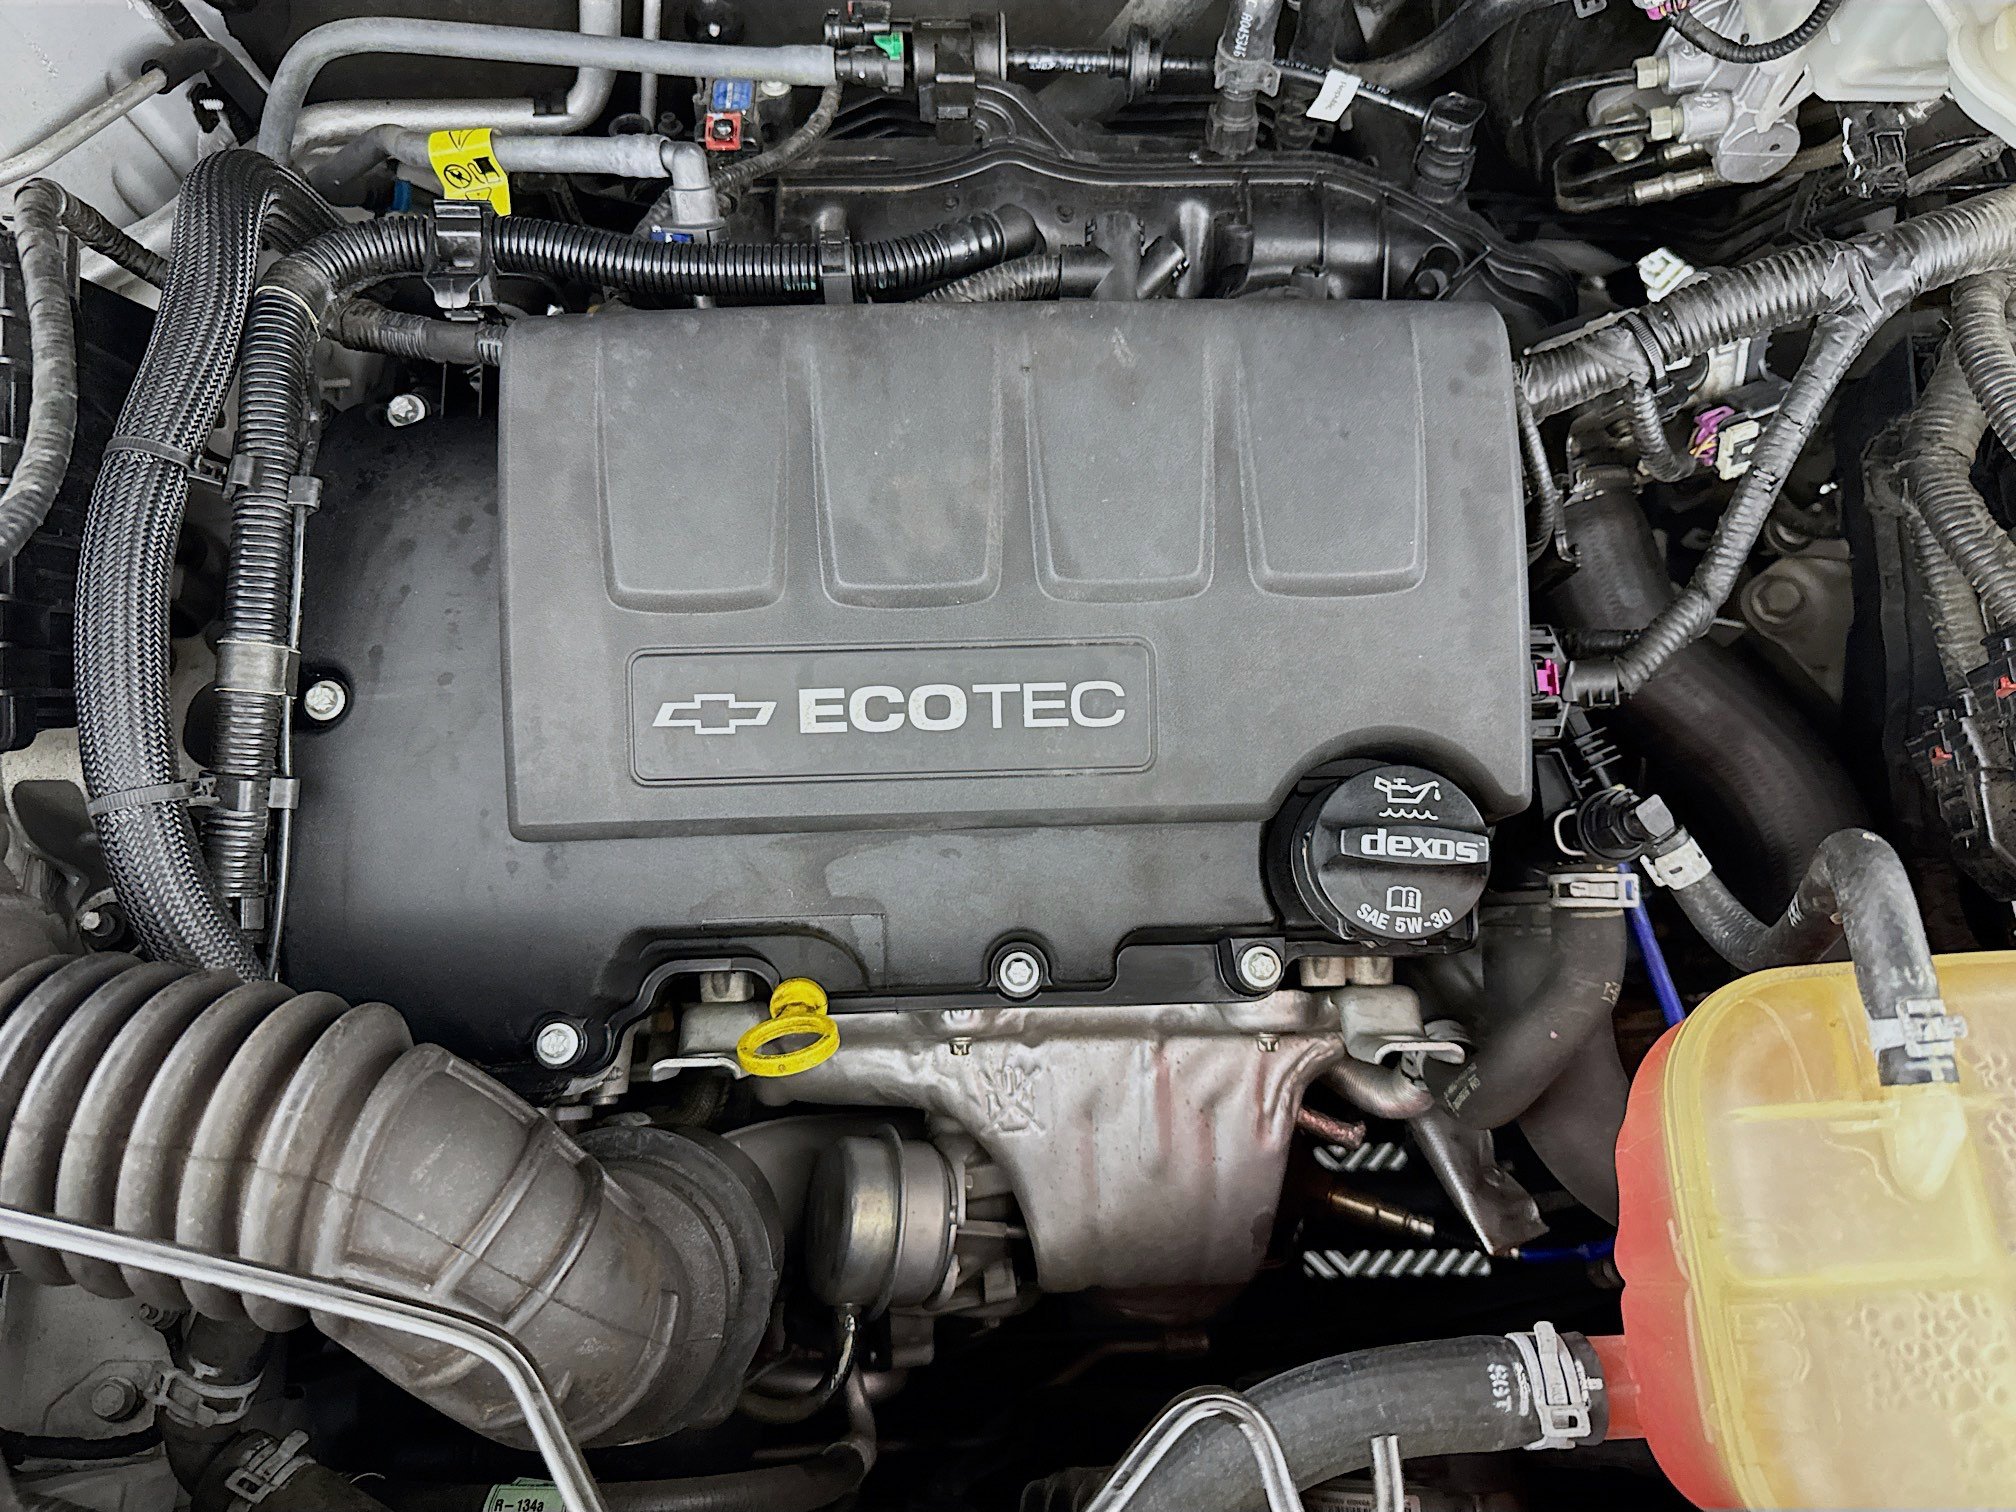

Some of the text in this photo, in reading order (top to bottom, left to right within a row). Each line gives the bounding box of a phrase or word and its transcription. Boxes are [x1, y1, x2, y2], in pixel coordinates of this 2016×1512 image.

[798, 680, 1126, 734] ECOTEC
[1360, 827, 1479, 863] dexos
[1356, 903, 1454, 934] SAE 5W-30
